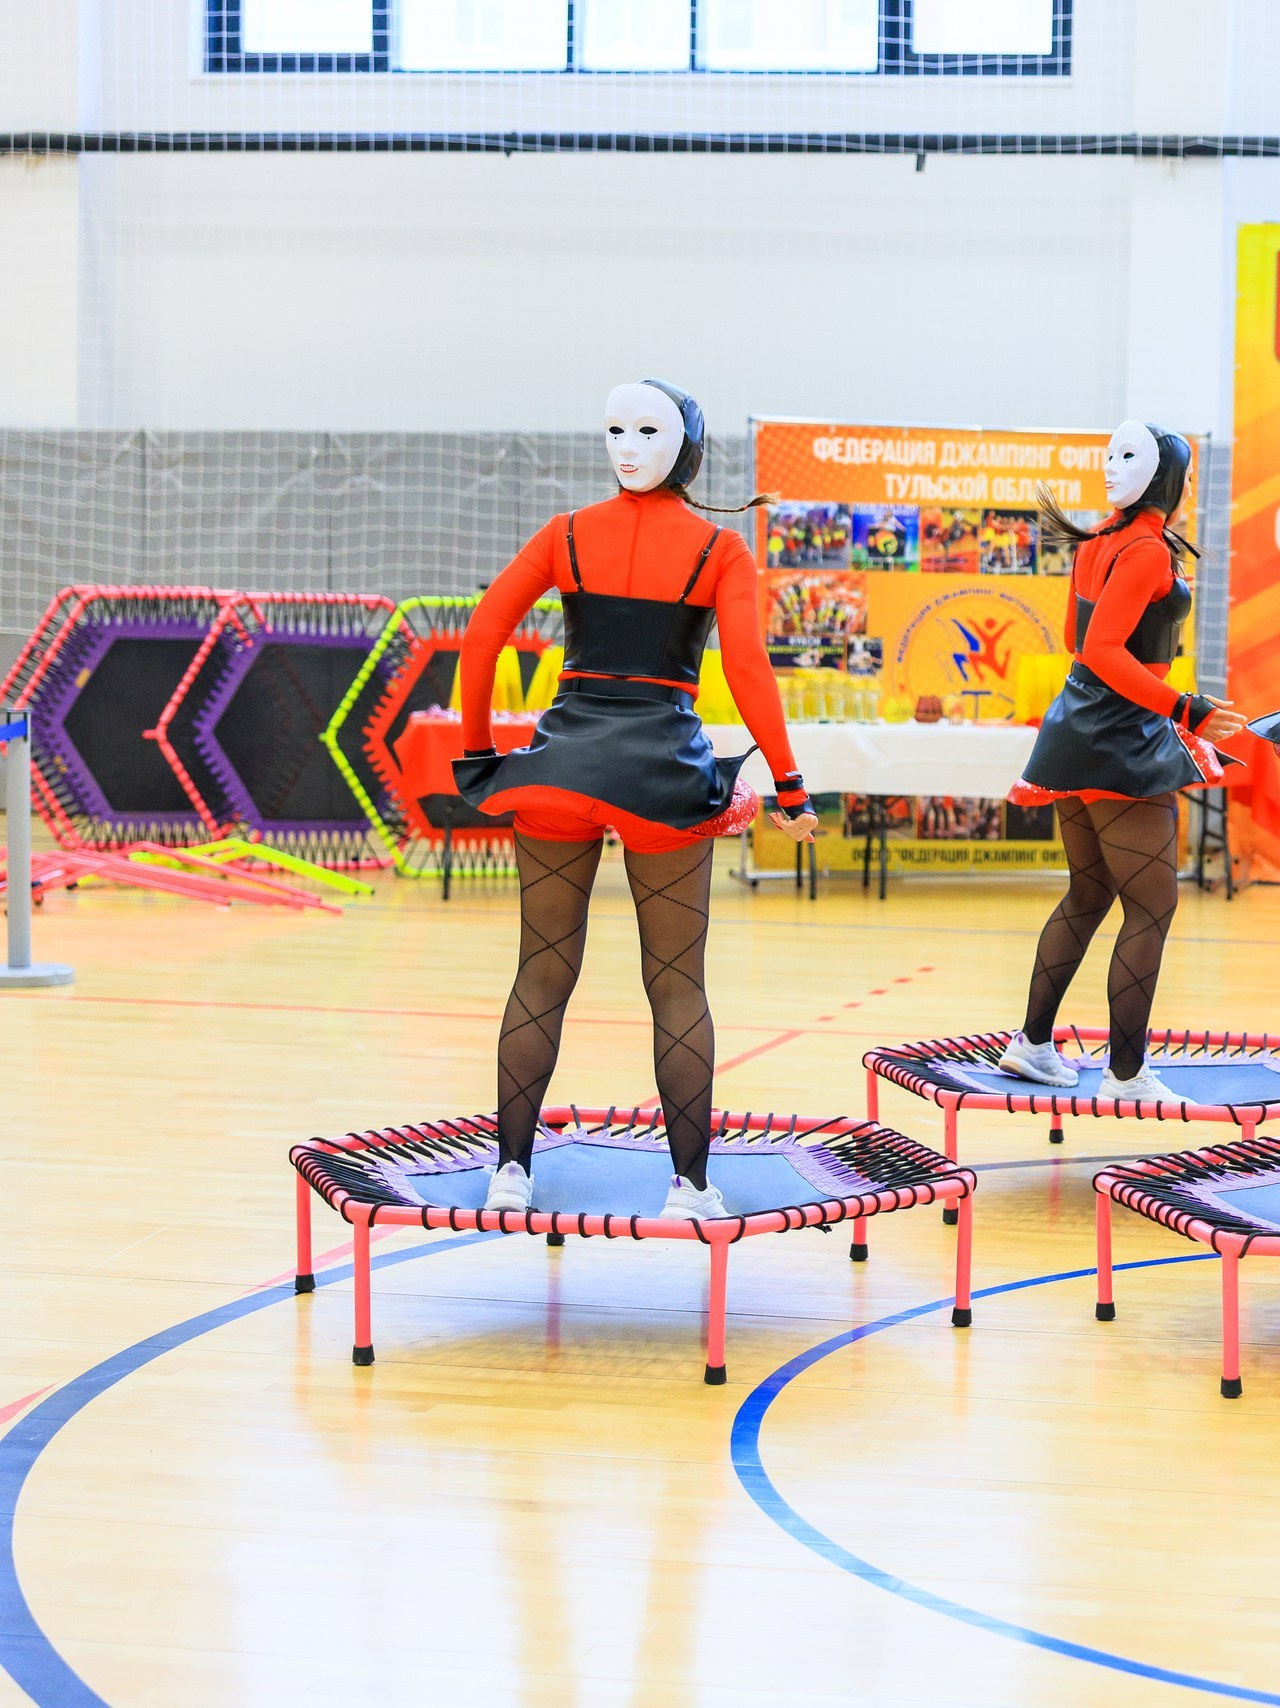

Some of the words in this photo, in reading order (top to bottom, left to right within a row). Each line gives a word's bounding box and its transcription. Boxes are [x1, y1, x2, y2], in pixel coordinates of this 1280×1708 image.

[813, 436, 936, 465] ФЕДЕРАЦИЯ
[939, 440, 1055, 470] ДЖАМПИНГ
[884, 472, 988, 501] ТУЛЬСКОЙ
[993, 476, 1081, 503] ОБЛАСТИ
